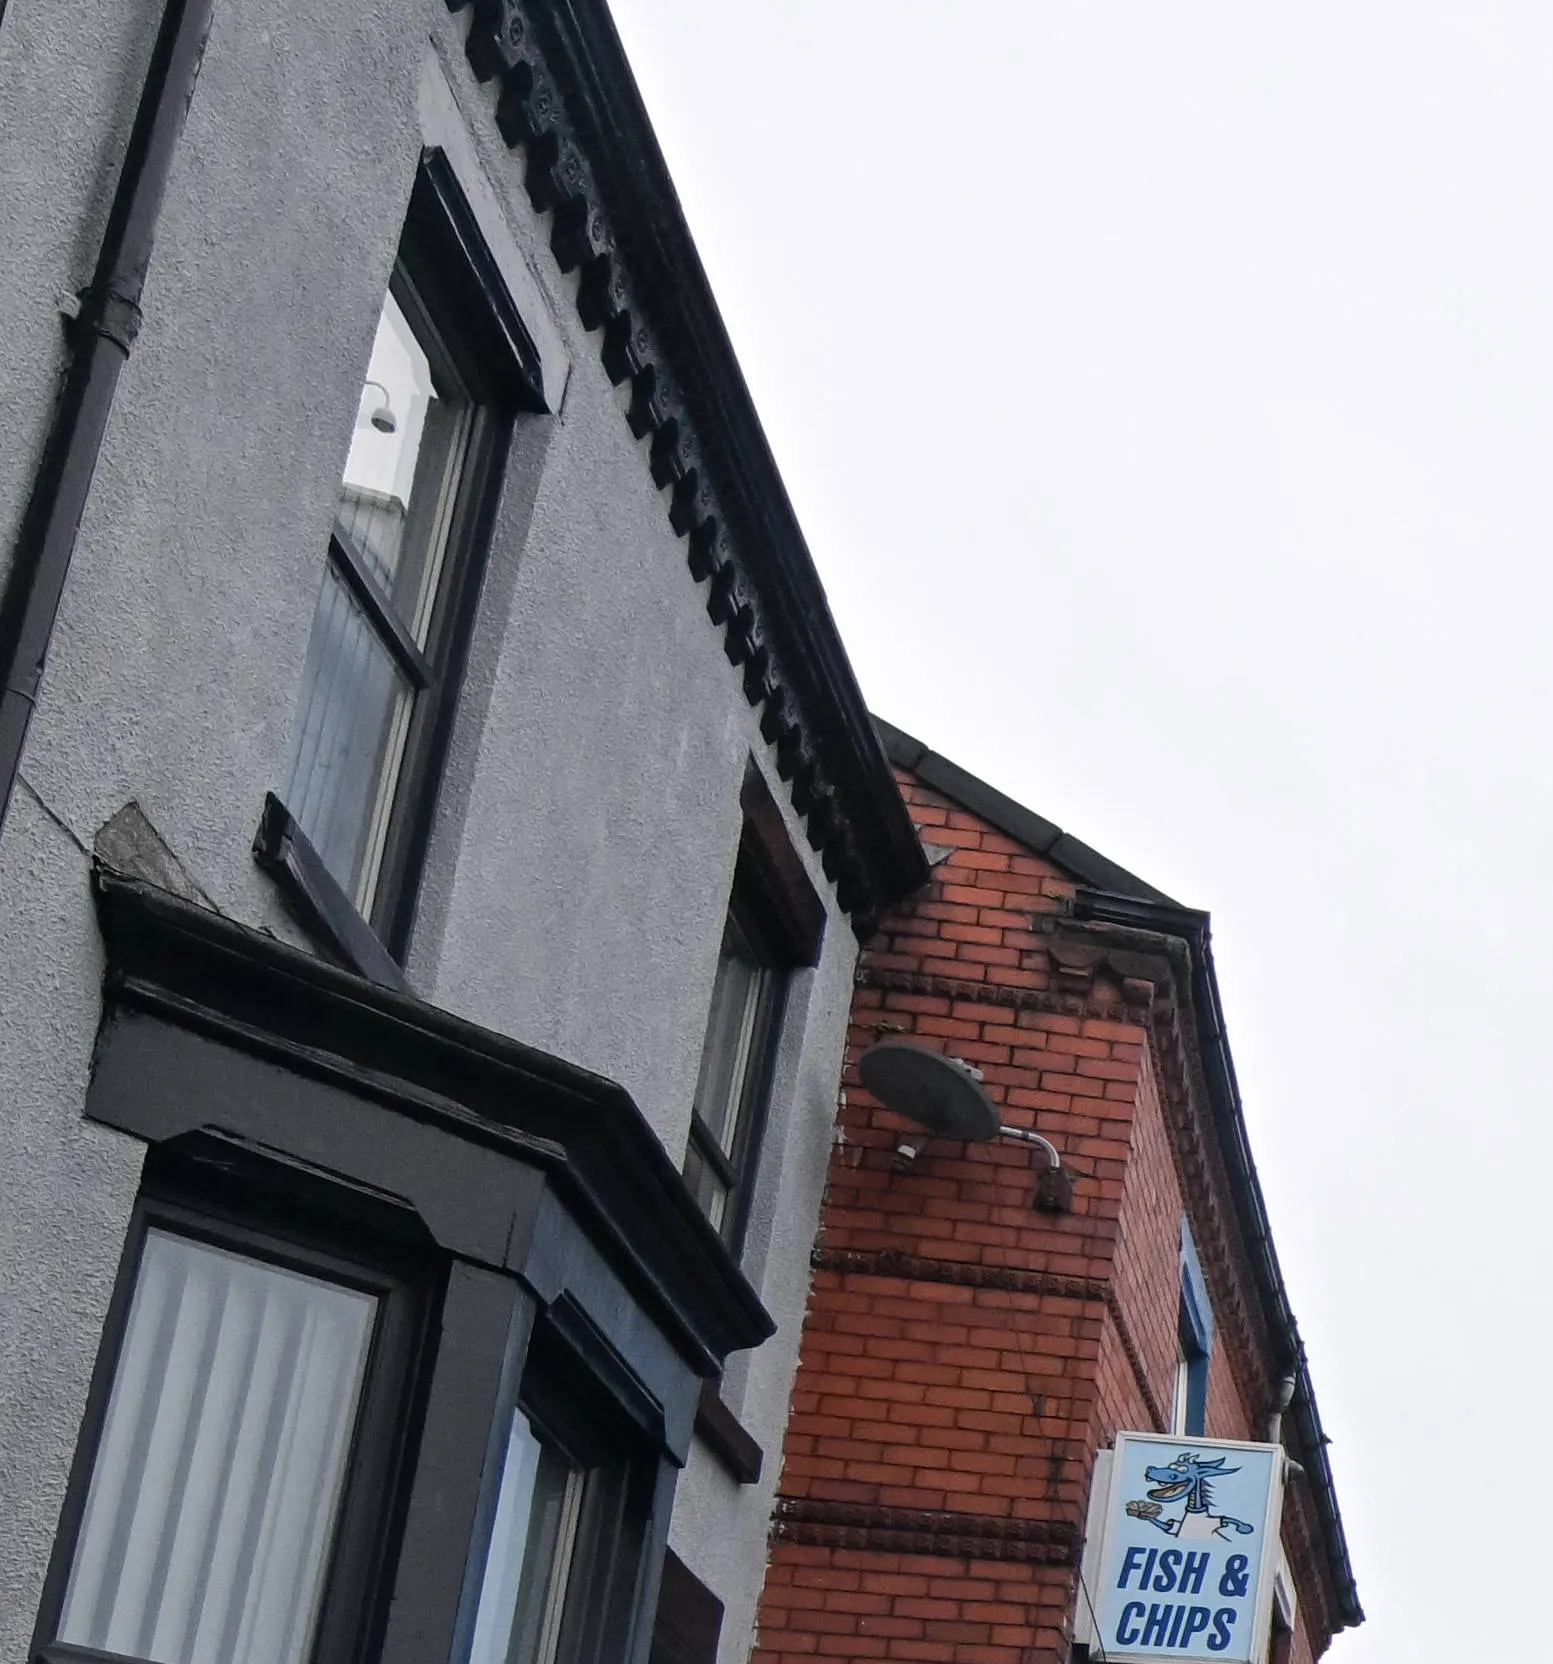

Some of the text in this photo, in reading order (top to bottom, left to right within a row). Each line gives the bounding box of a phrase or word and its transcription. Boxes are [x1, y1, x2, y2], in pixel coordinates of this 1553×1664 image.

[1117, 1546, 1250, 1597] FISH &
[1116, 1601, 1237, 1651] CHIPS
